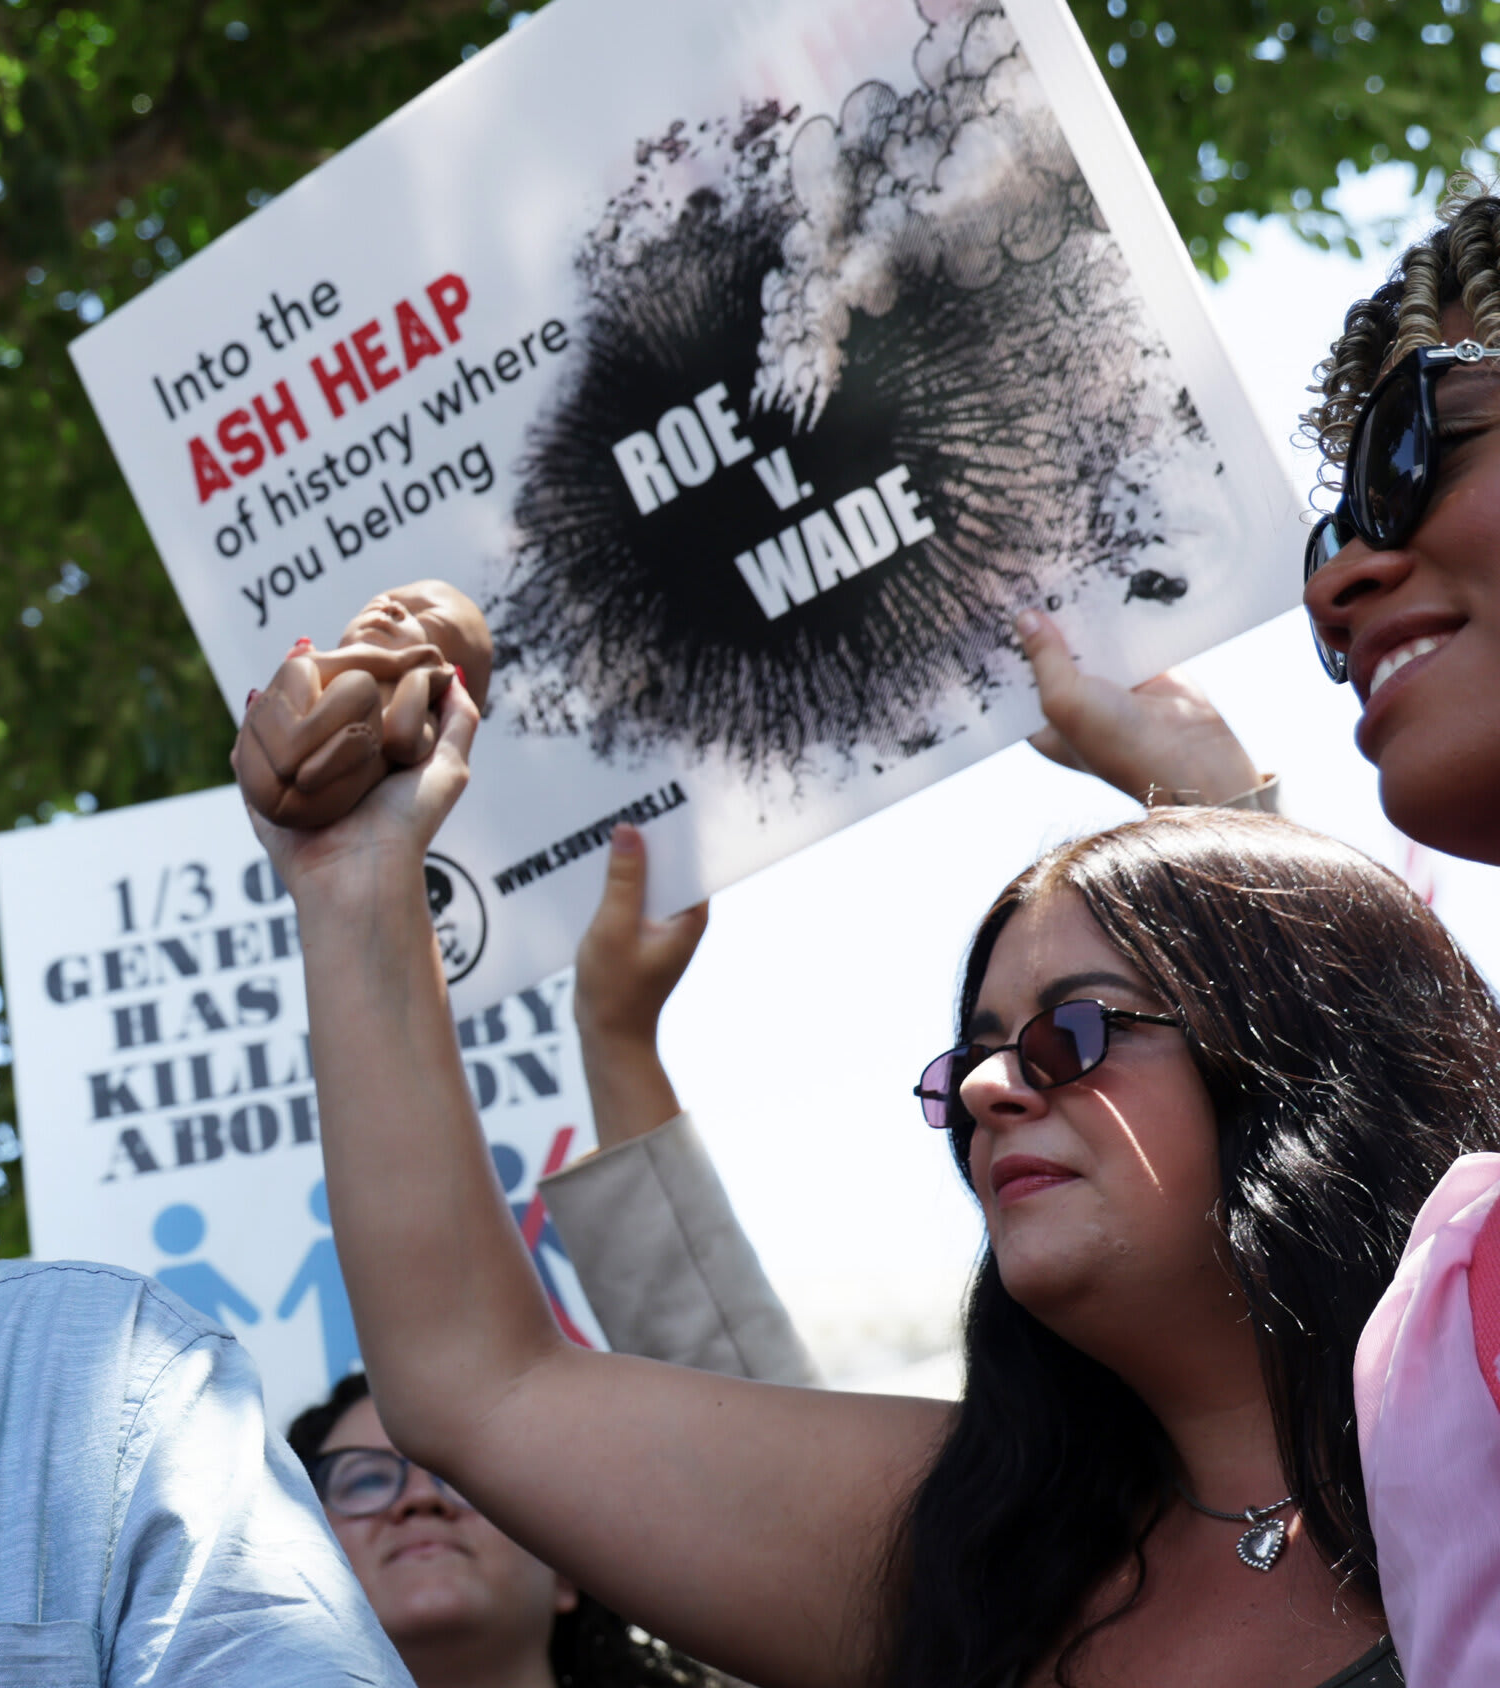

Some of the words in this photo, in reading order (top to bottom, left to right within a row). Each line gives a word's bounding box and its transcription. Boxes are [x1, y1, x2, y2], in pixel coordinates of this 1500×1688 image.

[152, 341, 250, 421] Into
[256, 279, 341, 352] the
[187, 379, 309, 505] ASH
[309, 272, 471, 419] HEAP
[214, 497, 259, 559] of
[262, 413, 413, 528] history
[422, 317, 571, 426] where
[612, 381, 755, 516] ROE
[241, 544, 325, 627] you
[326, 442, 496, 559] belong
[734, 464, 936, 621] WADE
[112, 861, 215, 938] 1/3
[243, 860, 289, 904] O
[85, 1031, 314, 1123] KILL
[457, 980, 568, 1049] BY
[110, 975, 282, 1051] HAS
